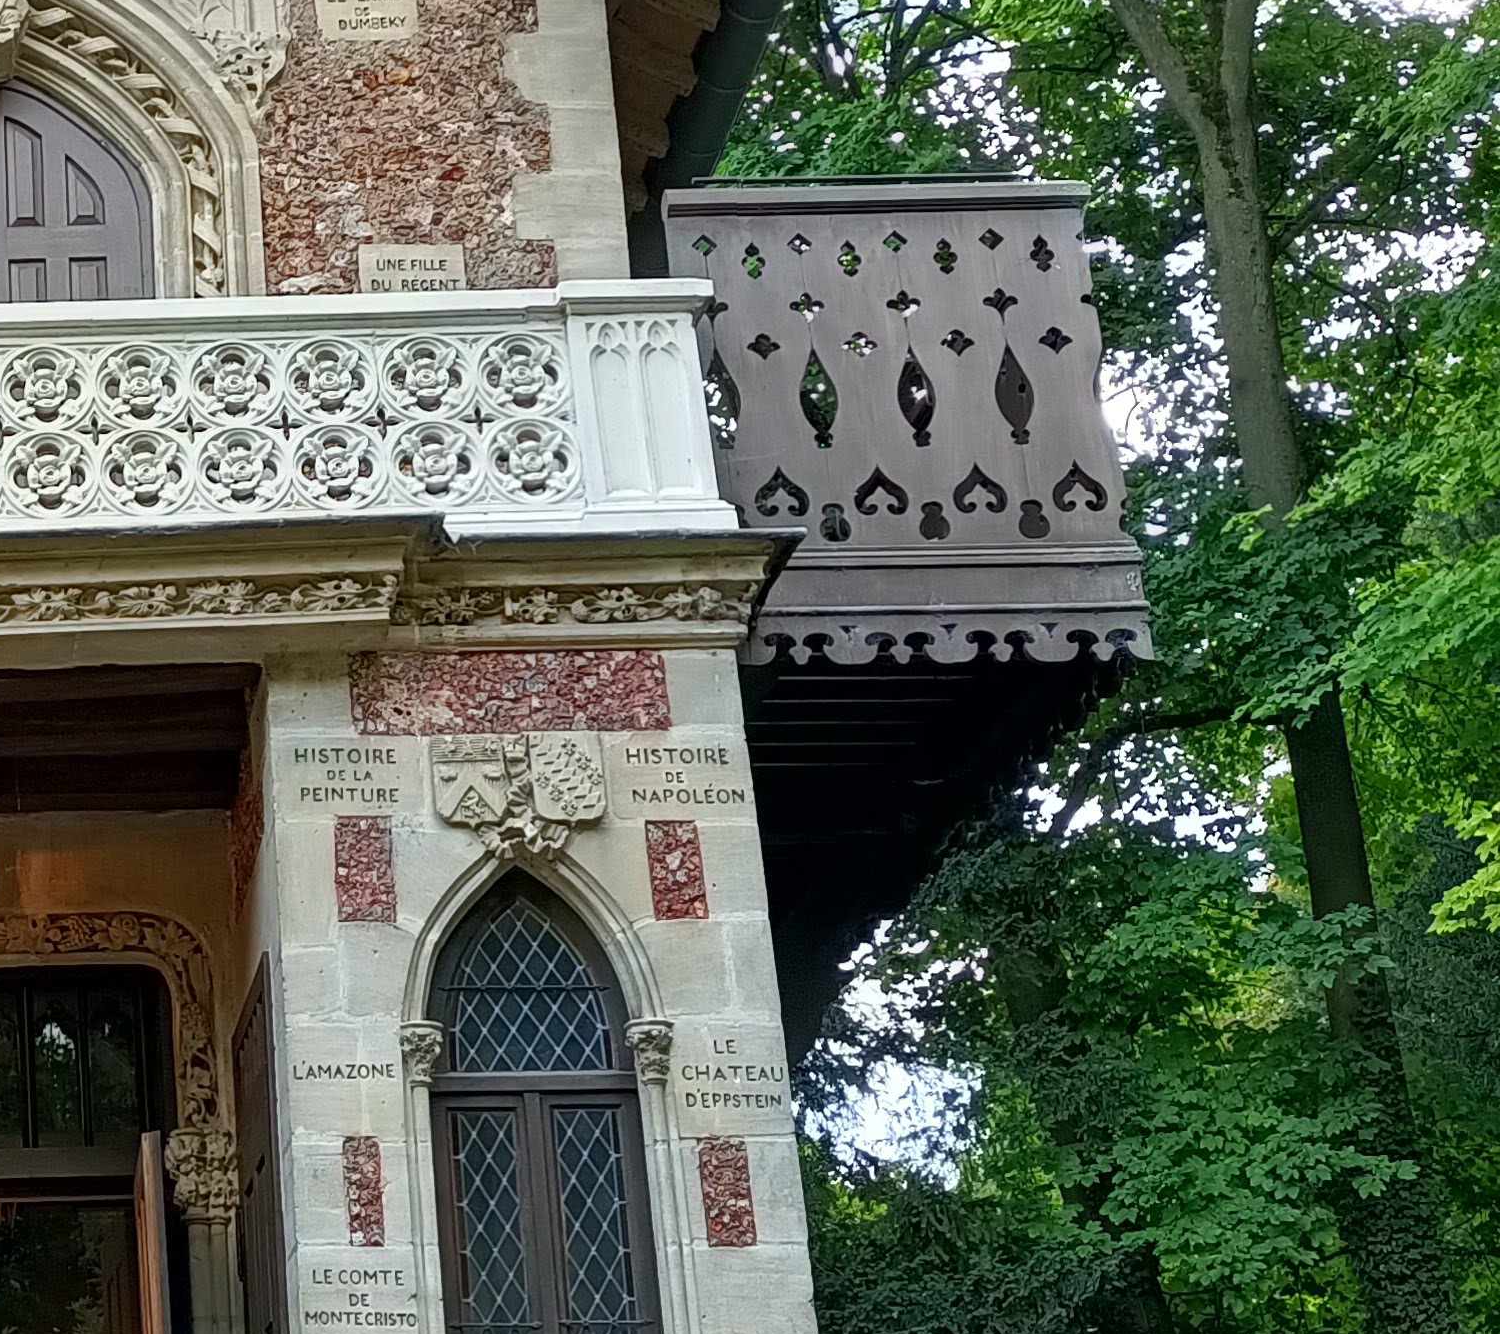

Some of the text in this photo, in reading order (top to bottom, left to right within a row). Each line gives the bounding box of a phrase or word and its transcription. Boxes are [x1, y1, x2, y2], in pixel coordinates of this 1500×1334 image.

[354, 6, 371, 17] DE
[376, 258, 448, 271] UNE FILLE
[371, 278, 392, 292] DU
[294, 747, 397, 764] HISTOIRE
[625, 747, 730, 765] HISTOIRE
[327, 769, 374, 781] DE LA
[665, 771, 685, 783] DE
[300, 787, 400, 803] PEINTURE
[632, 782, 745, 804] NAPOLÉON
[713, 1039, 737, 1054] LE
[292, 1059, 396, 1080] L'AMAZONE
[681, 1064, 784, 1082] CHATEAU
[685, 1087, 782, 1109] D'EPPSTEIN
[312, 1269, 405, 1286] LE COMTE
[348, 1293, 370, 1307] DE
